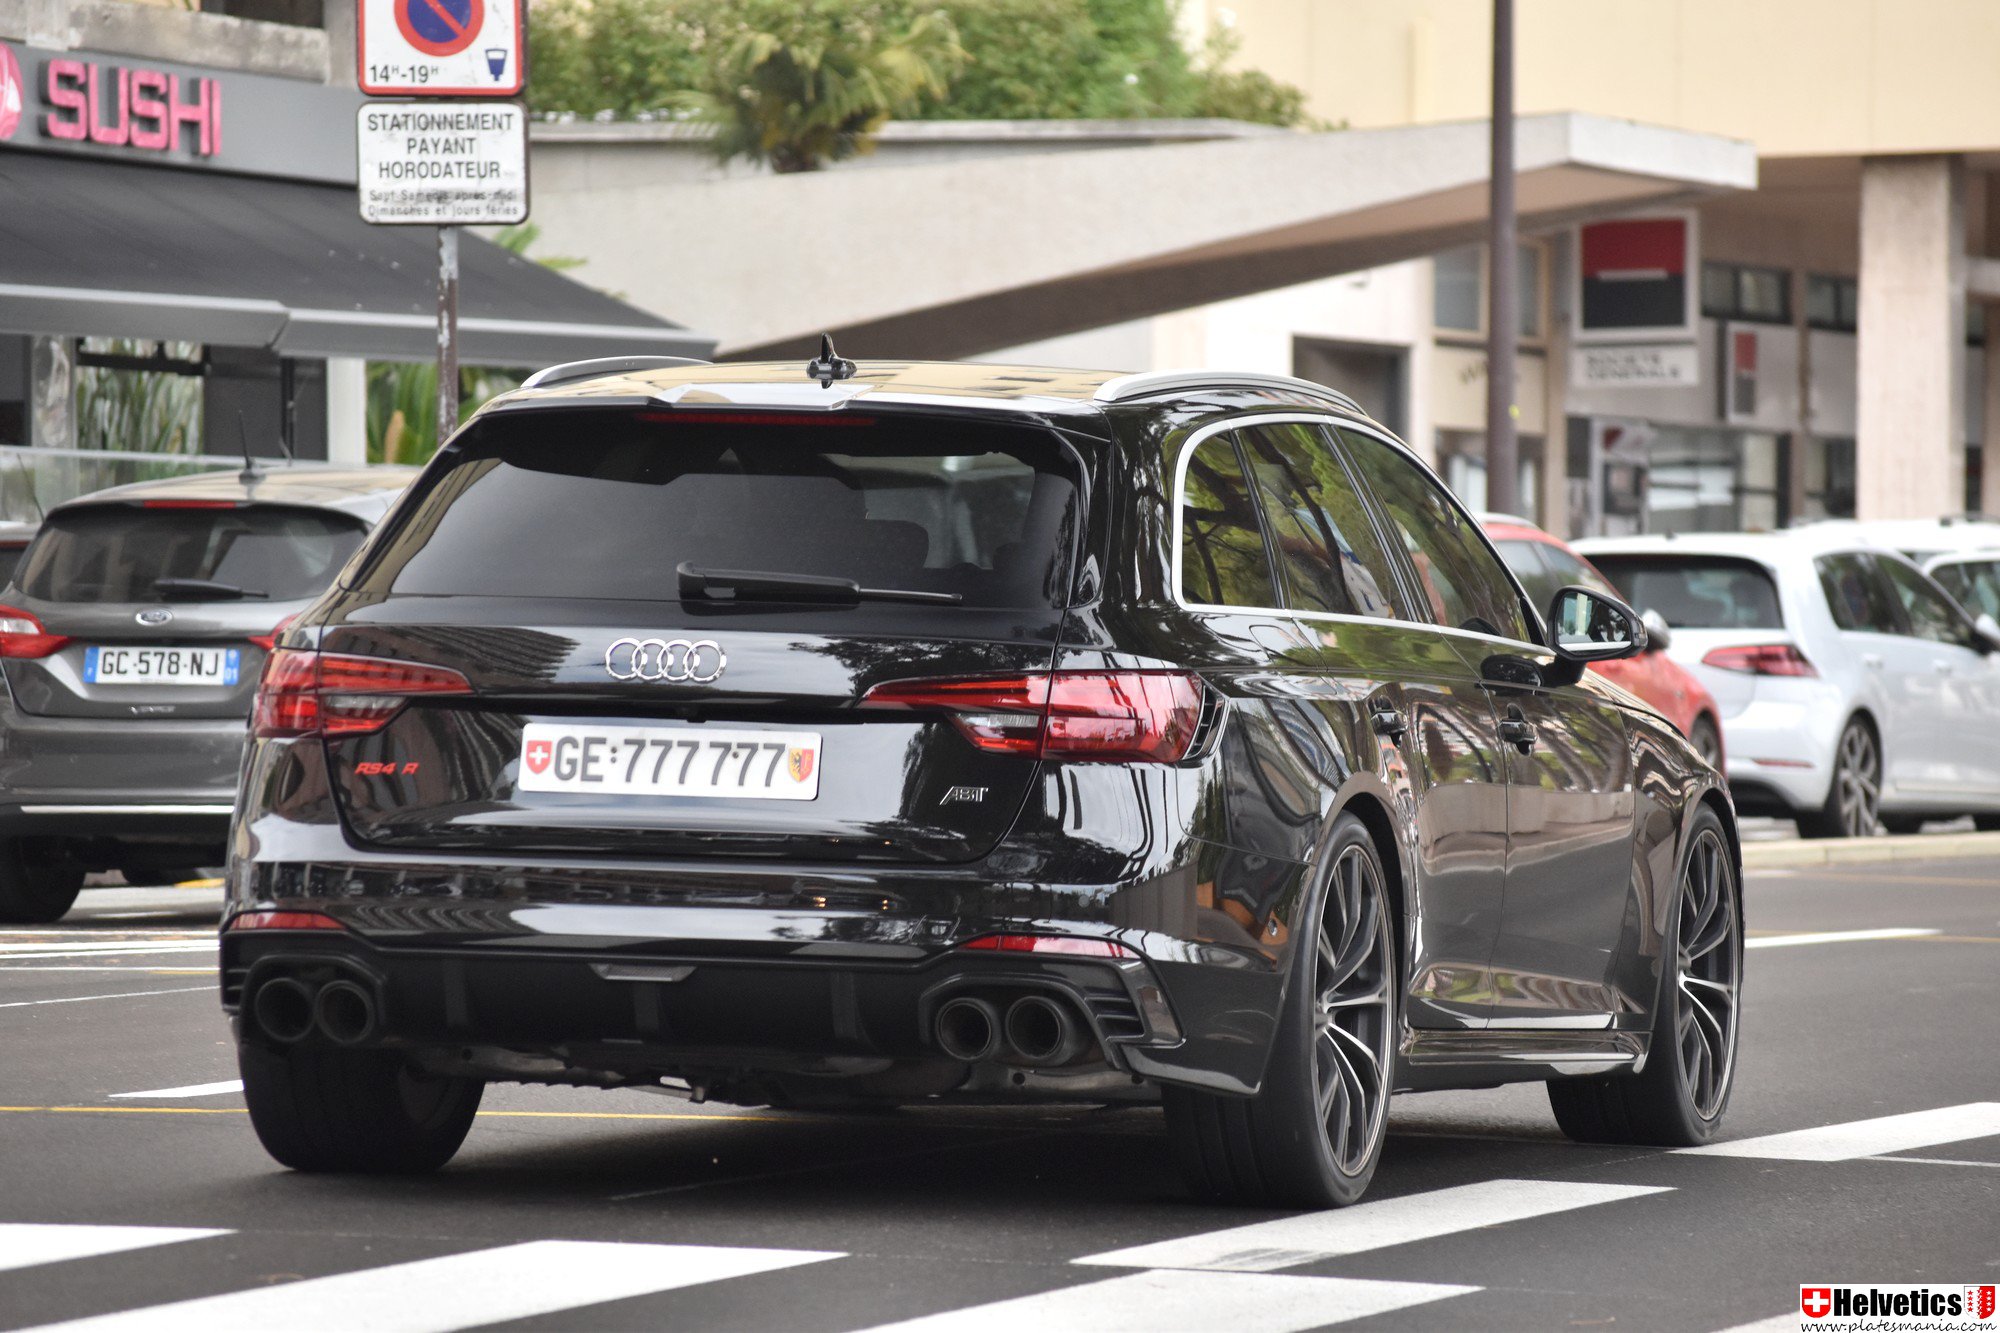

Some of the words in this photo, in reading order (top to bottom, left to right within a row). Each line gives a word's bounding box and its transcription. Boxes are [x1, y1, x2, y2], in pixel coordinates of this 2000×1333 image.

[46, 58, 222, 157] SUSHI
[367, 113, 514, 132] STATIONNEMENT
[407, 138, 476, 154] PAYANT
[379, 161, 500, 178] HORODATEUR
[435, 205, 446, 215] et
[355, 762, 397, 775] RS4
[402, 762, 419, 775] R
